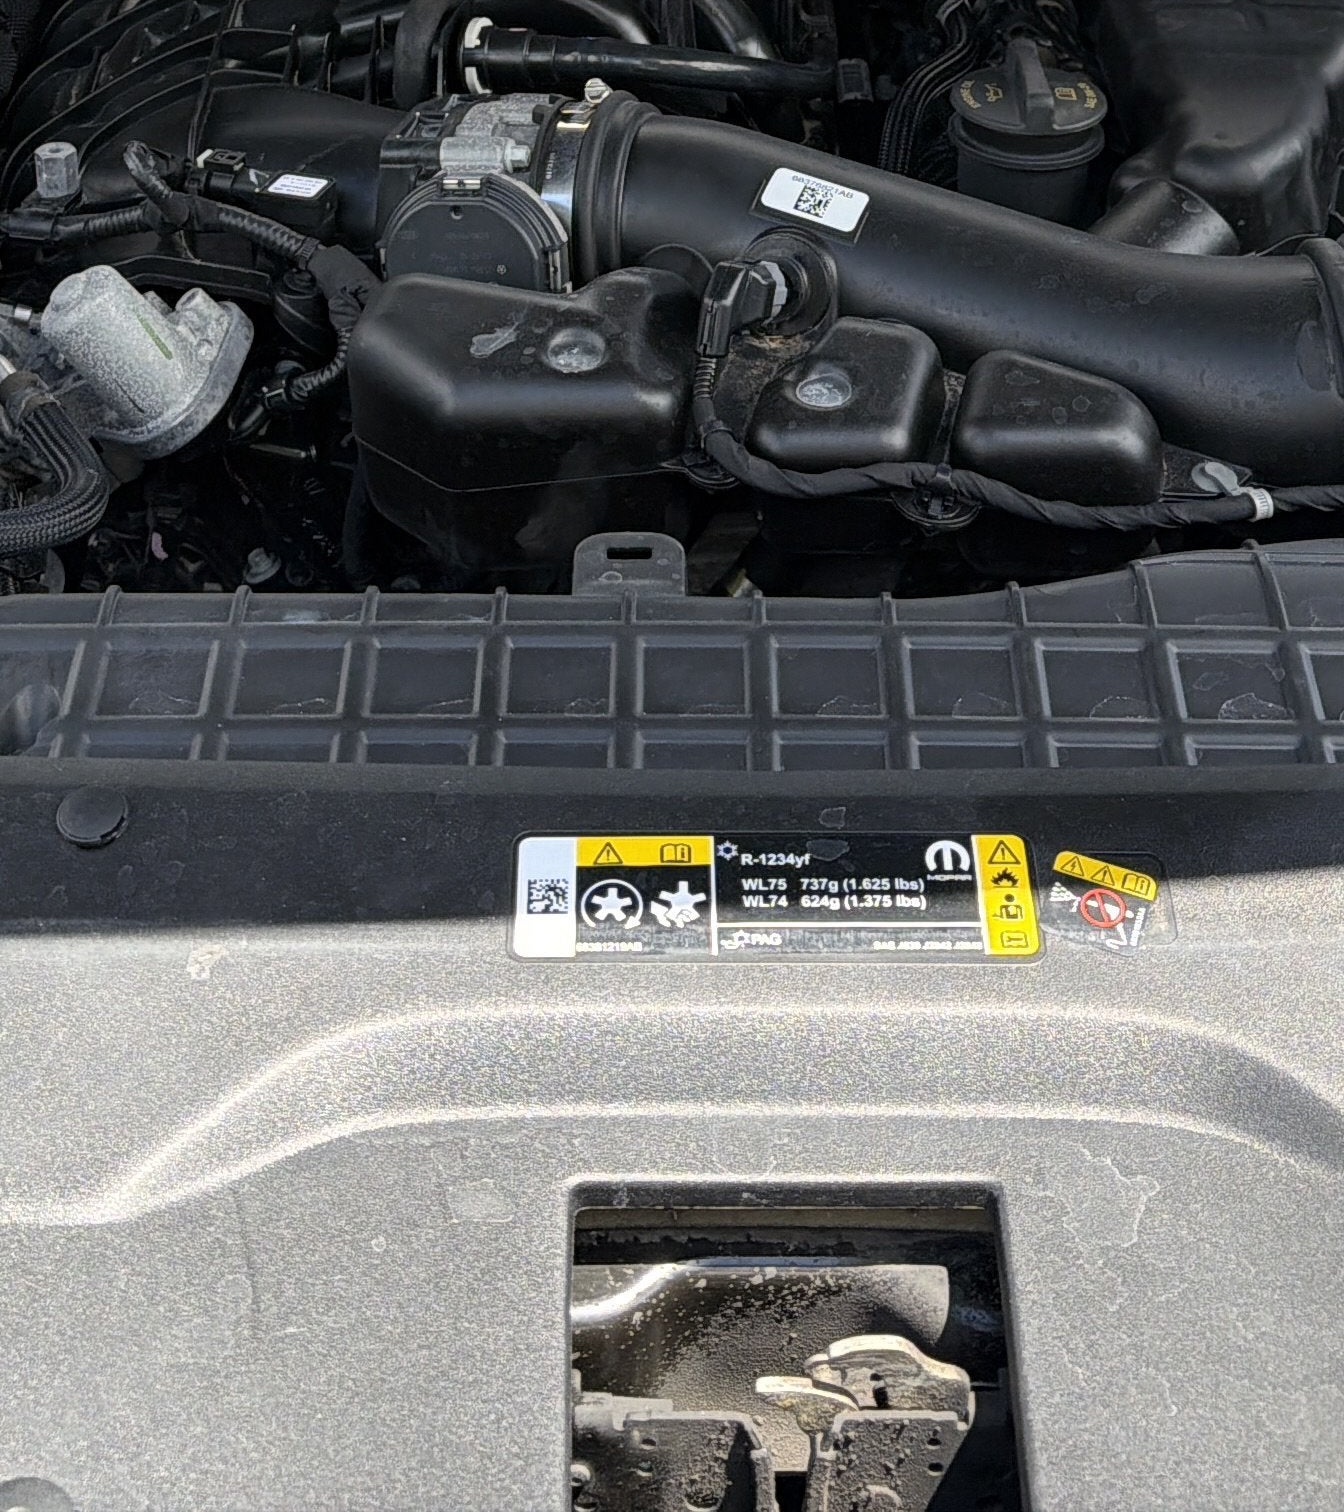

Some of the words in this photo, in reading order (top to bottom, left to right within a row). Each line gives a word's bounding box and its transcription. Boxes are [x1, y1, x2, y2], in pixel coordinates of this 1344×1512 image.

[741, 853, 811, 869] R-1234yf
[742, 878, 788, 891] WL75
[800, 878, 839, 892] 737g
[842, 877, 891, 893] (1.625
[894, 877, 925, 892] lbs)
[926, 873, 973, 881] MOPAR
[742, 894, 789, 908] WL74
[801, 894, 841, 910] 624g
[843, 894, 893, 910] (1.375
[895, 894, 927, 910] lbs)
[750, 932, 783, 946] PAG
